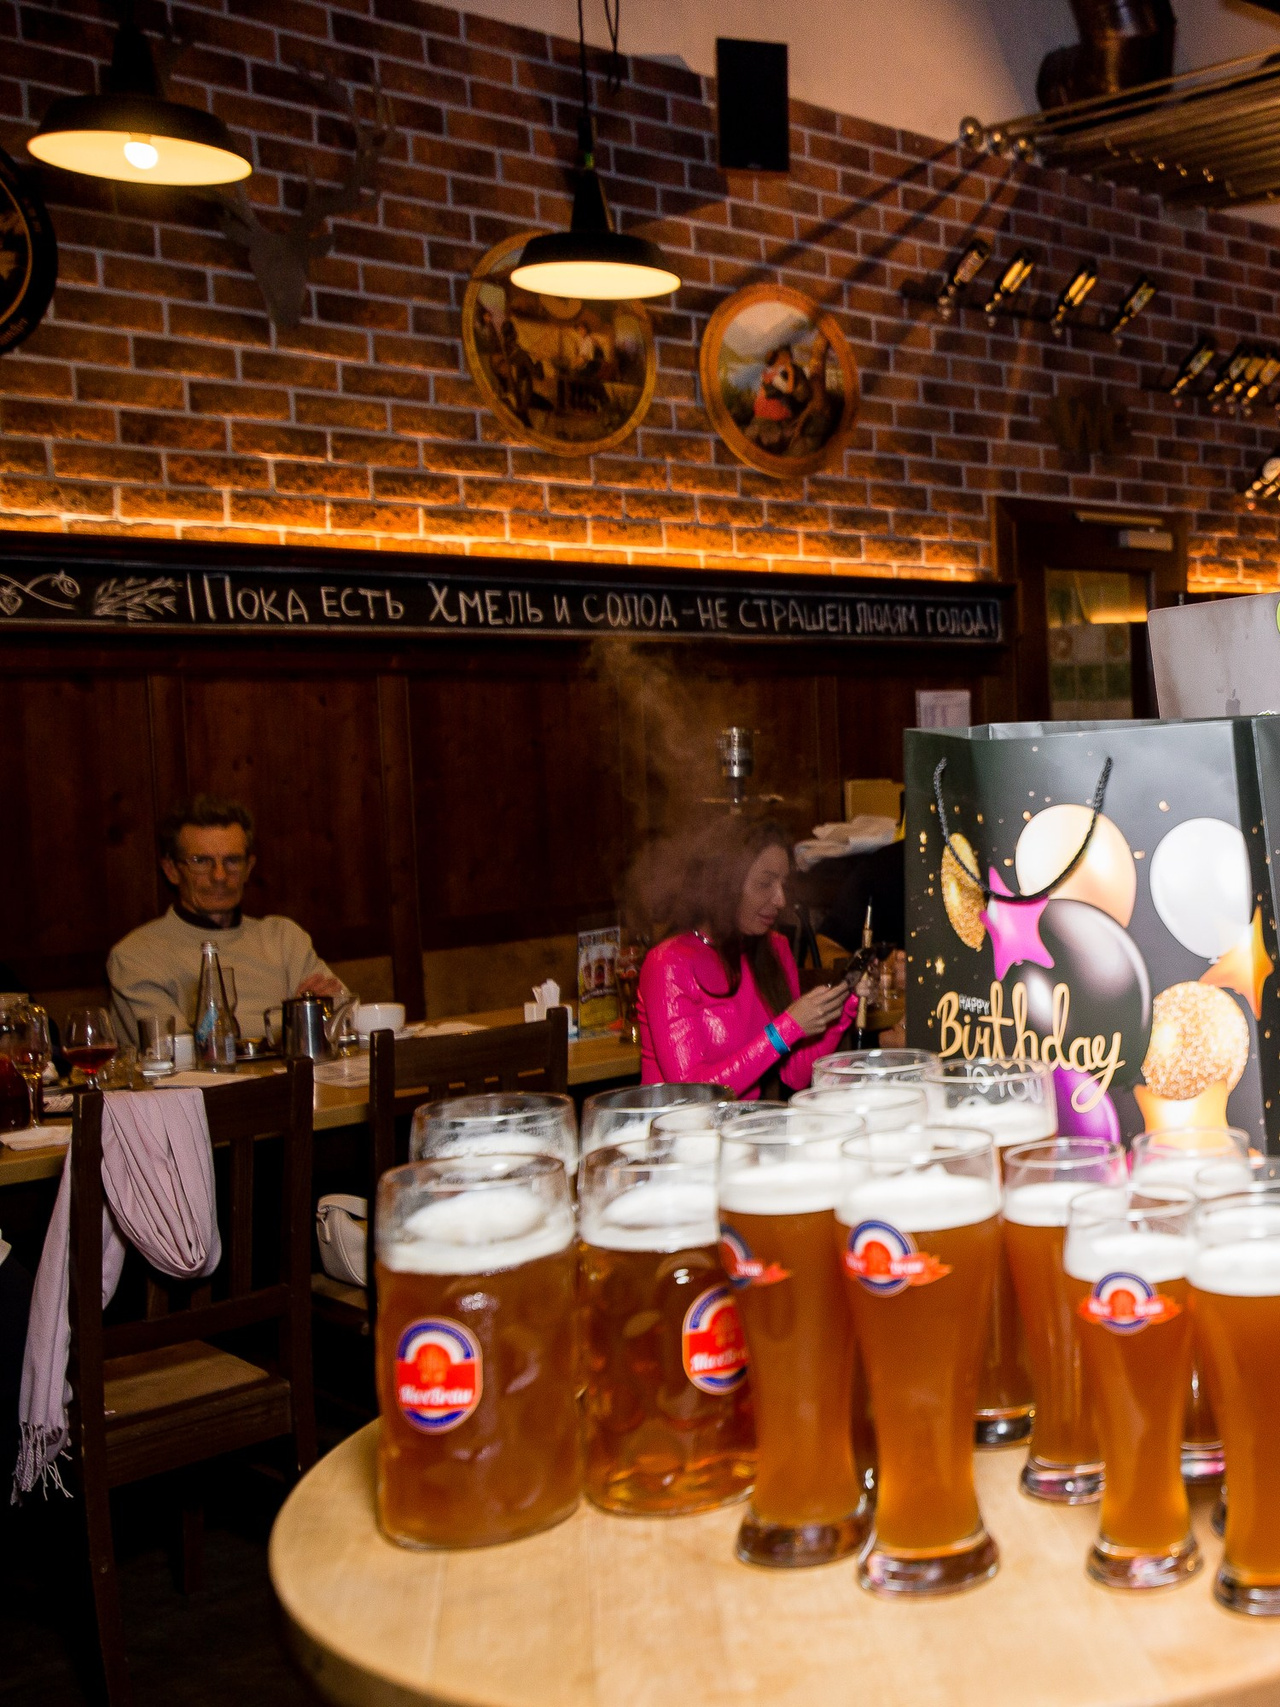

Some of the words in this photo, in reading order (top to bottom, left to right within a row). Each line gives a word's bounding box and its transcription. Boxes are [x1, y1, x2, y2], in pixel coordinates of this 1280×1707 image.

[320, 585, 405, 620] ЕСТЬ
[428, 581, 544, 626] ХМЕЛЬ
[553, 594, 571, 625] И
[738, 598, 851, 634] СТРАШЕН
[856, 601, 919, 635] ЛЮДЯМ
[959, 993, 990, 1016] HAPPY
[937, 980, 1127, 1114] Birthday
